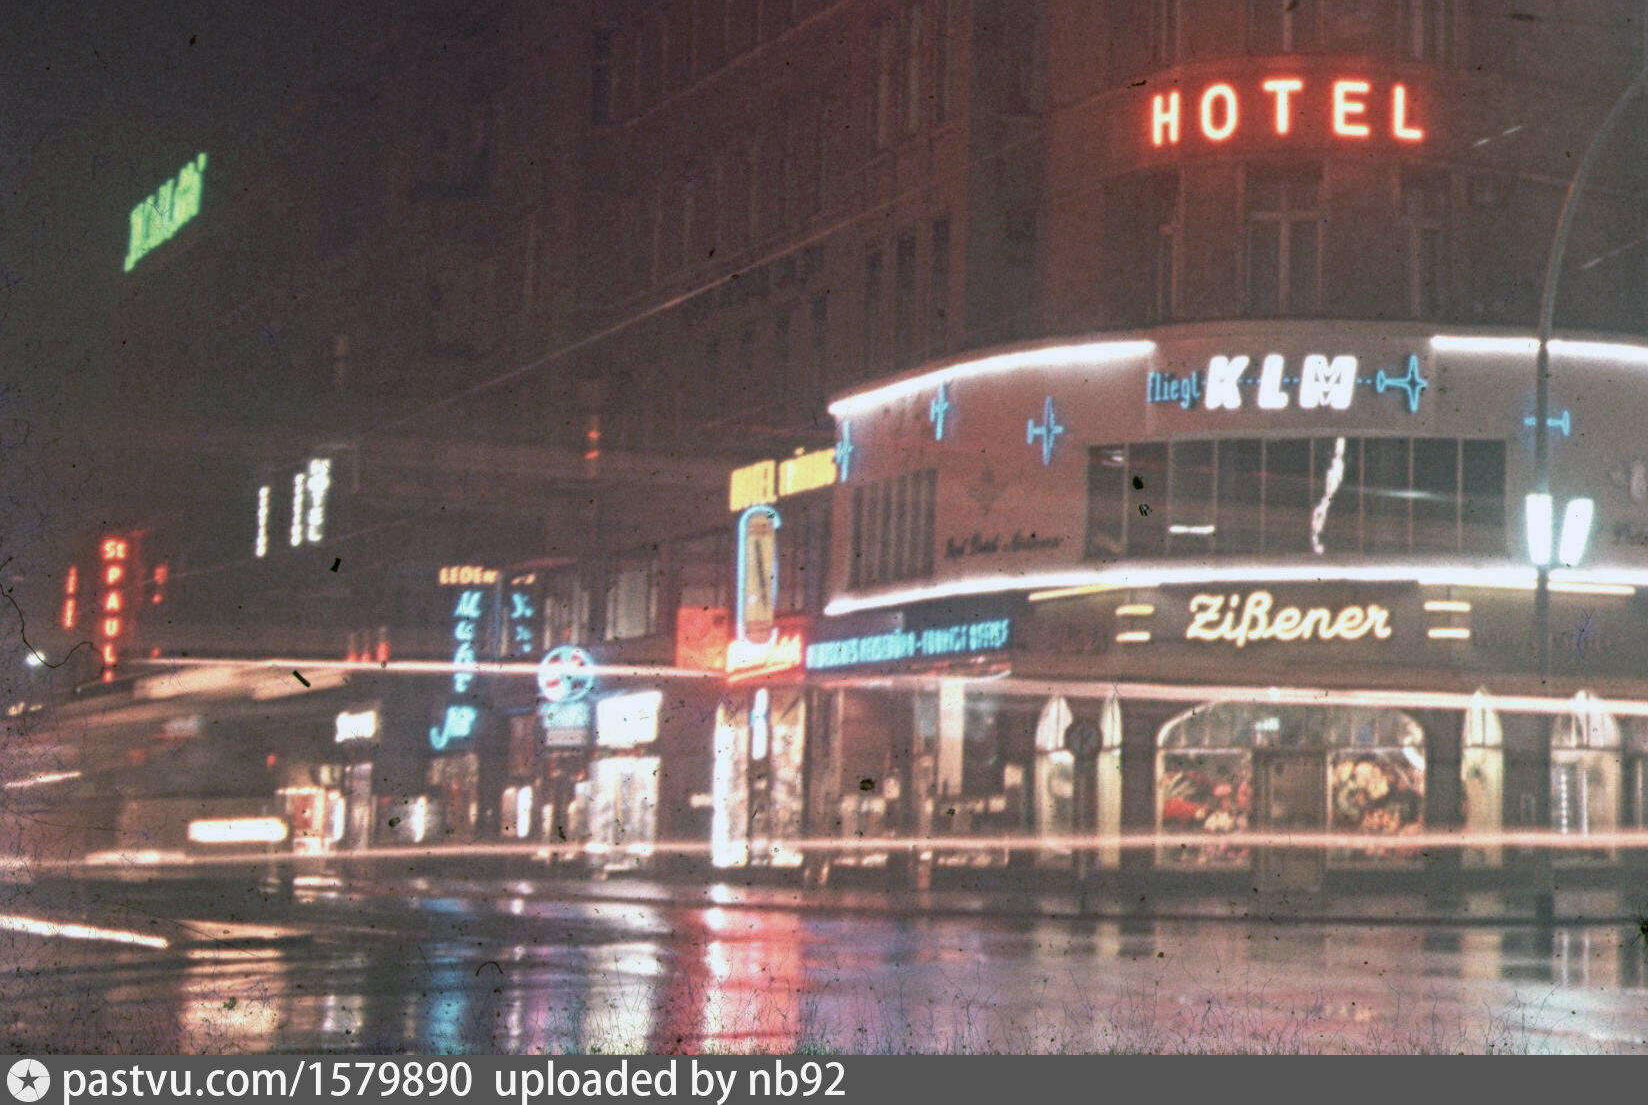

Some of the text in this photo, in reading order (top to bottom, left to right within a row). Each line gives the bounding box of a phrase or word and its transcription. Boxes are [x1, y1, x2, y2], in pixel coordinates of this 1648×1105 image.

[1150, 79, 1426, 145] HOTEL
[1145, 353, 1358, 411] fliegt KLM
[1187, 591, 1393, 650] Zißener
